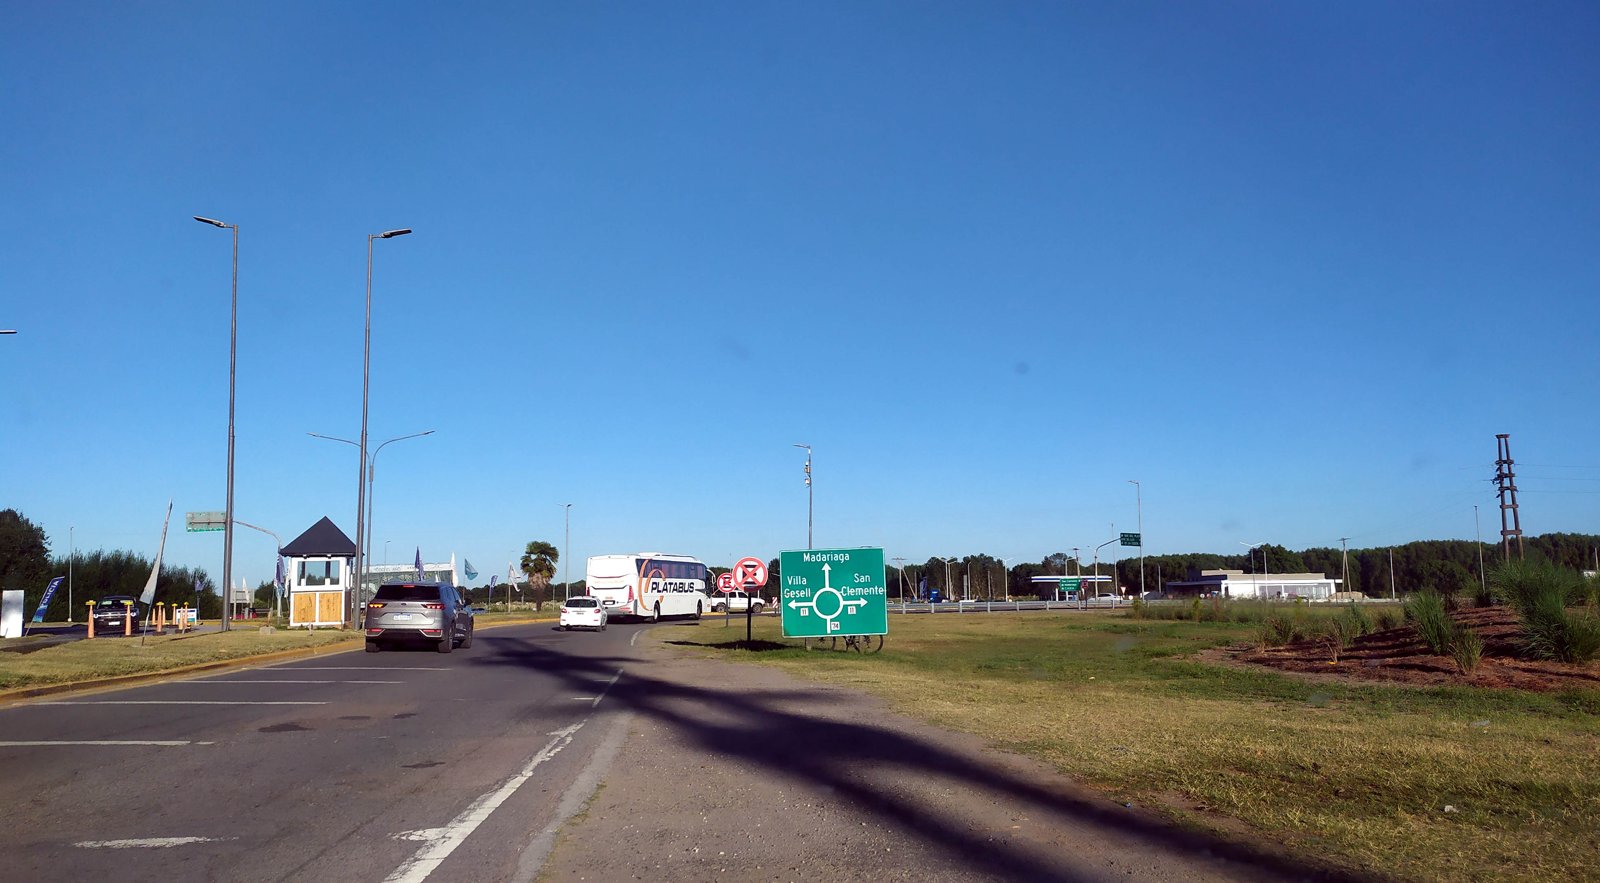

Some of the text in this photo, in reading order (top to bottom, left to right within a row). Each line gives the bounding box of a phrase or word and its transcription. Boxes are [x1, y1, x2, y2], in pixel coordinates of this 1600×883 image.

[803, 552, 850, 563] Madariaga
[787, 576, 807, 585] Villa
[854, 573, 871, 583] San
[651, 582, 694, 593] PLATABUS
[841, 586, 884, 596] Clemente
[784, 588, 811, 598] Gesell
